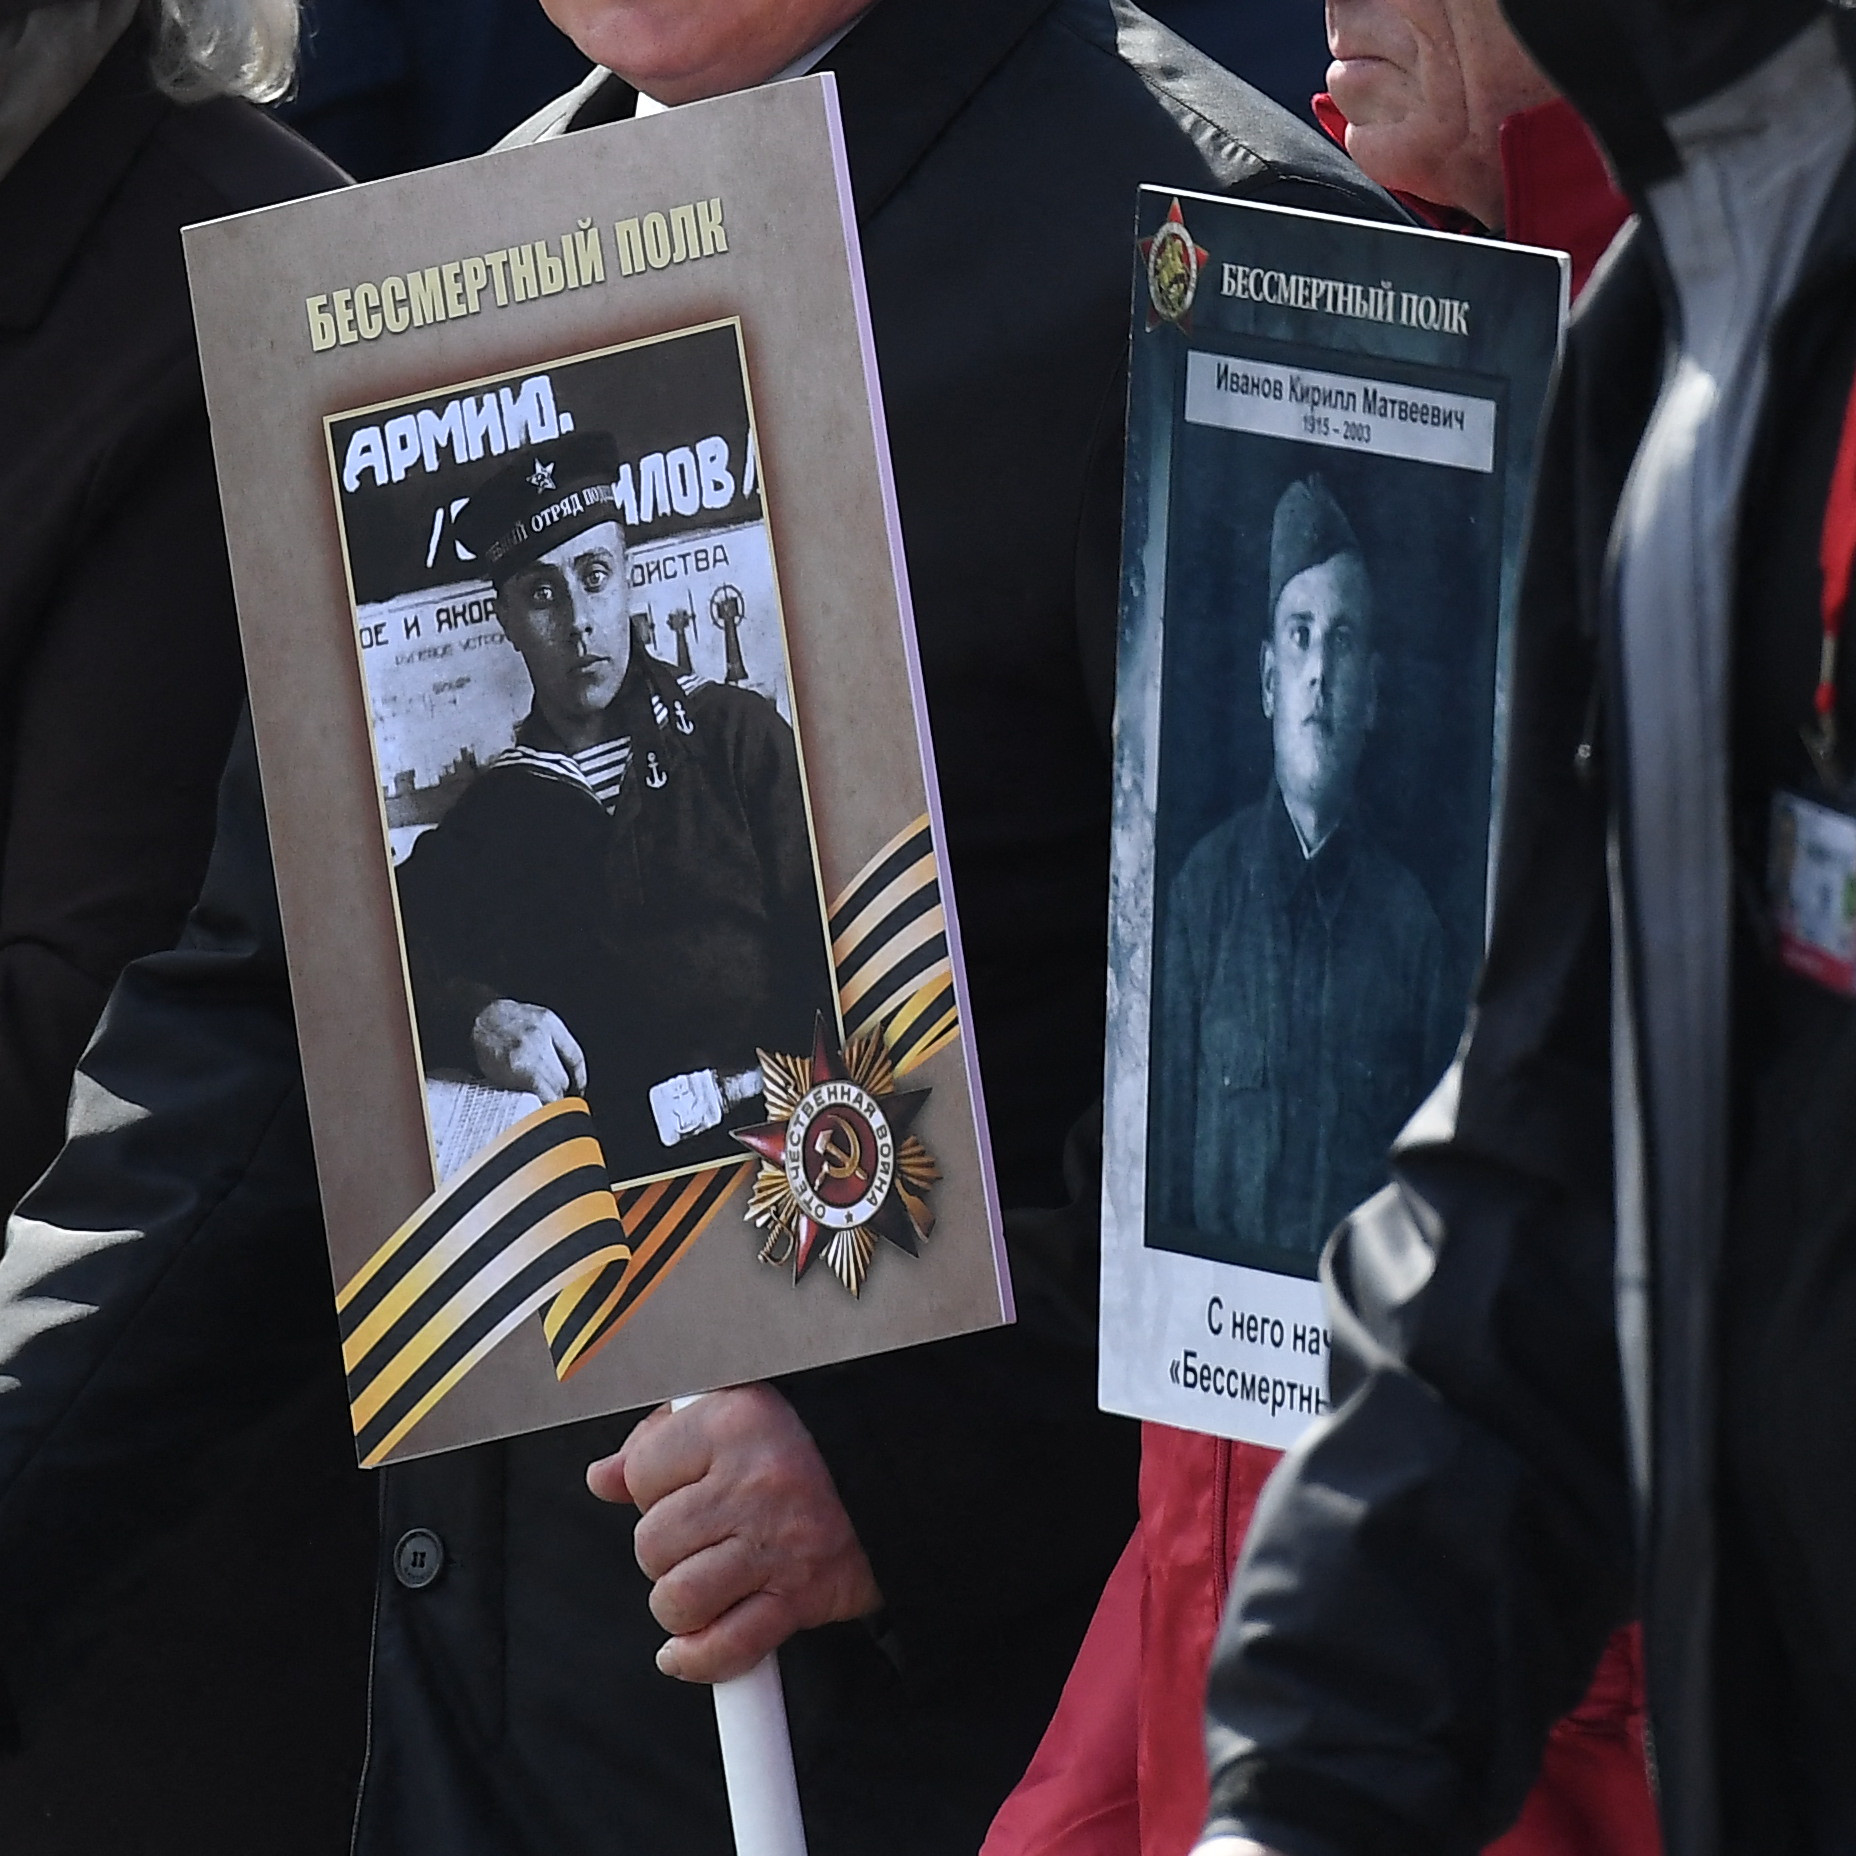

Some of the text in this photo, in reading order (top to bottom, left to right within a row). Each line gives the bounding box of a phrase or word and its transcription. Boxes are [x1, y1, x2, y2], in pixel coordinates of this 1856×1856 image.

[306, 197, 730, 351] БЕССМЕРТНЫЙ ПОЛК
[1221, 261, 1395, 323] БЕССМЕРТНЫЙ
[1400, 291, 1470, 336] ПОЛК
[1216, 362, 1465, 432] Иванов Кирилл Матвеевич
[1302, 413, 1330, 436] 1915
[1342, 419, 1372, 444] 2003
[343, 374, 575, 493] АРМИЮ.
[531, 492, 584, 532] ОТРЯД
[404, 615, 422, 640] И
[789, 1084, 892, 1220] ОТЕЧЕСТВЕННАЯ ВОЙНА
[1207, 1296, 1224, 1335] С
[1232, 1308, 1284, 1348] него
